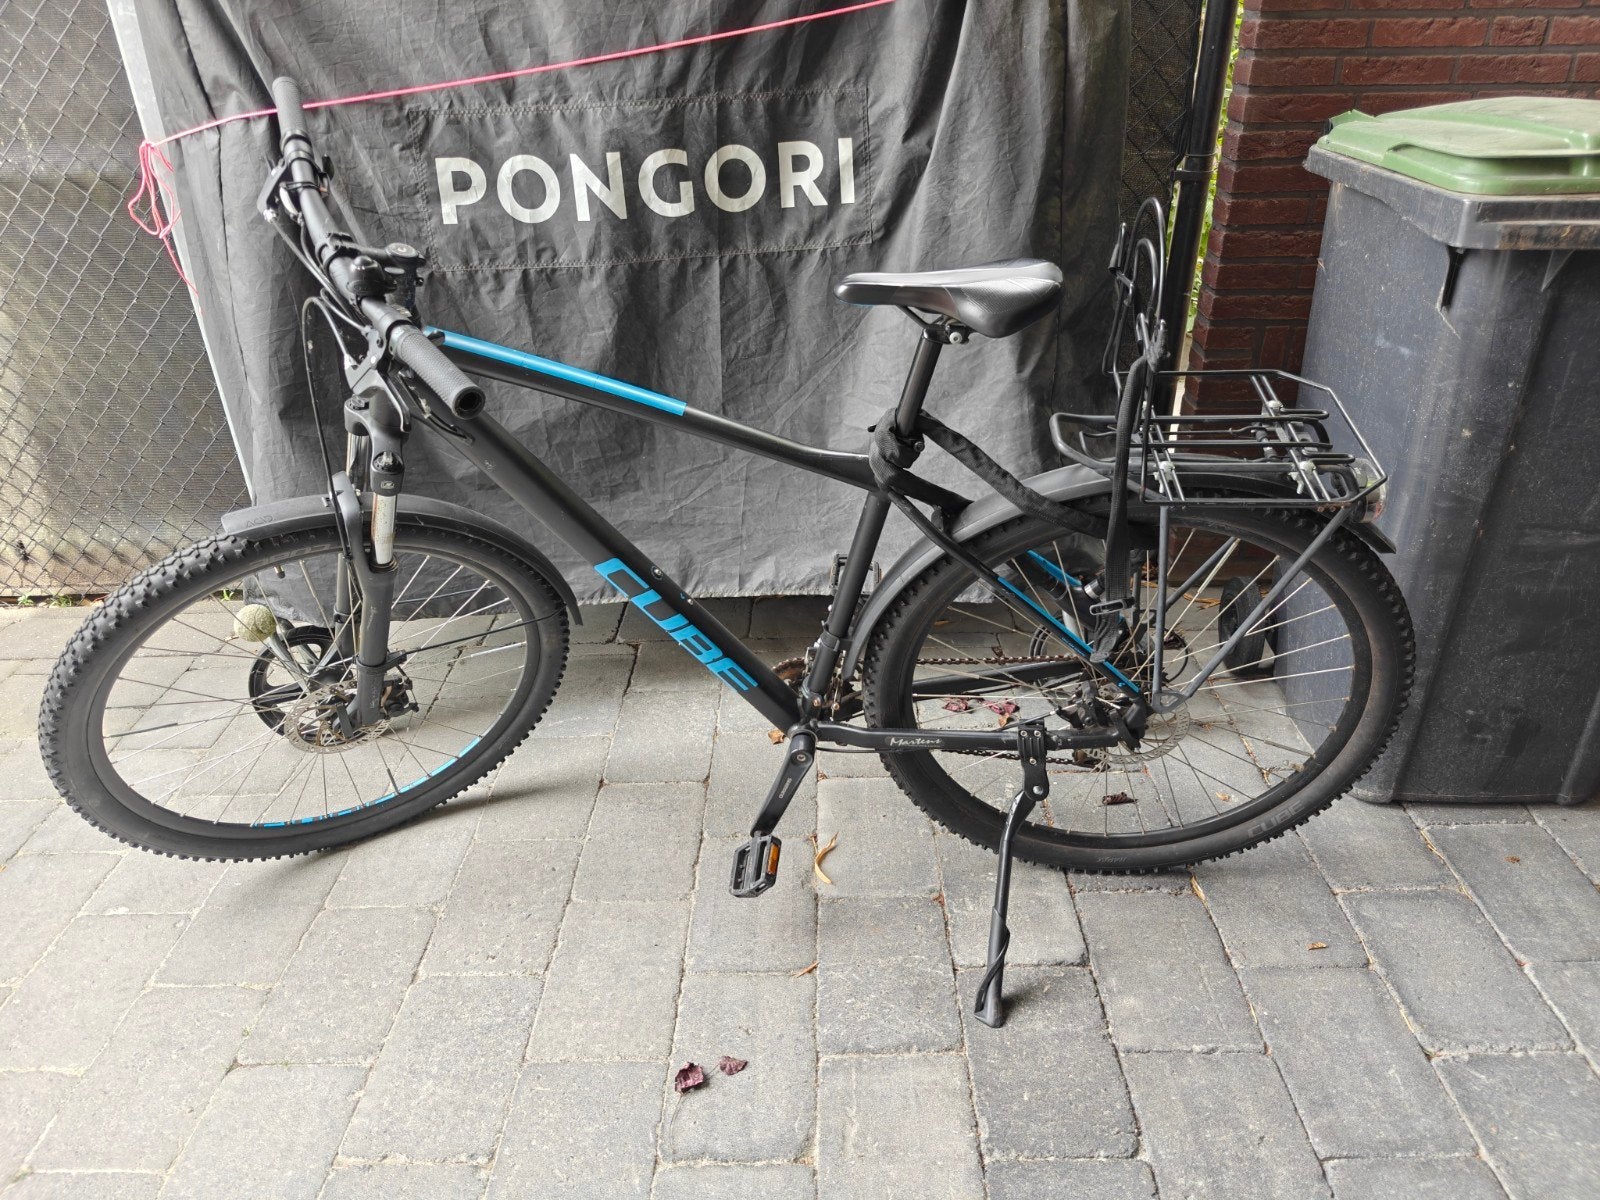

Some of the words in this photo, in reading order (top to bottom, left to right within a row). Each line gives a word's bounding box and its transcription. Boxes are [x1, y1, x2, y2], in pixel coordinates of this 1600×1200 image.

[435, 137, 856, 225] PONGORI
[593, 557, 760, 693] CUBE
[1247, 800, 1306, 839] CUBE
